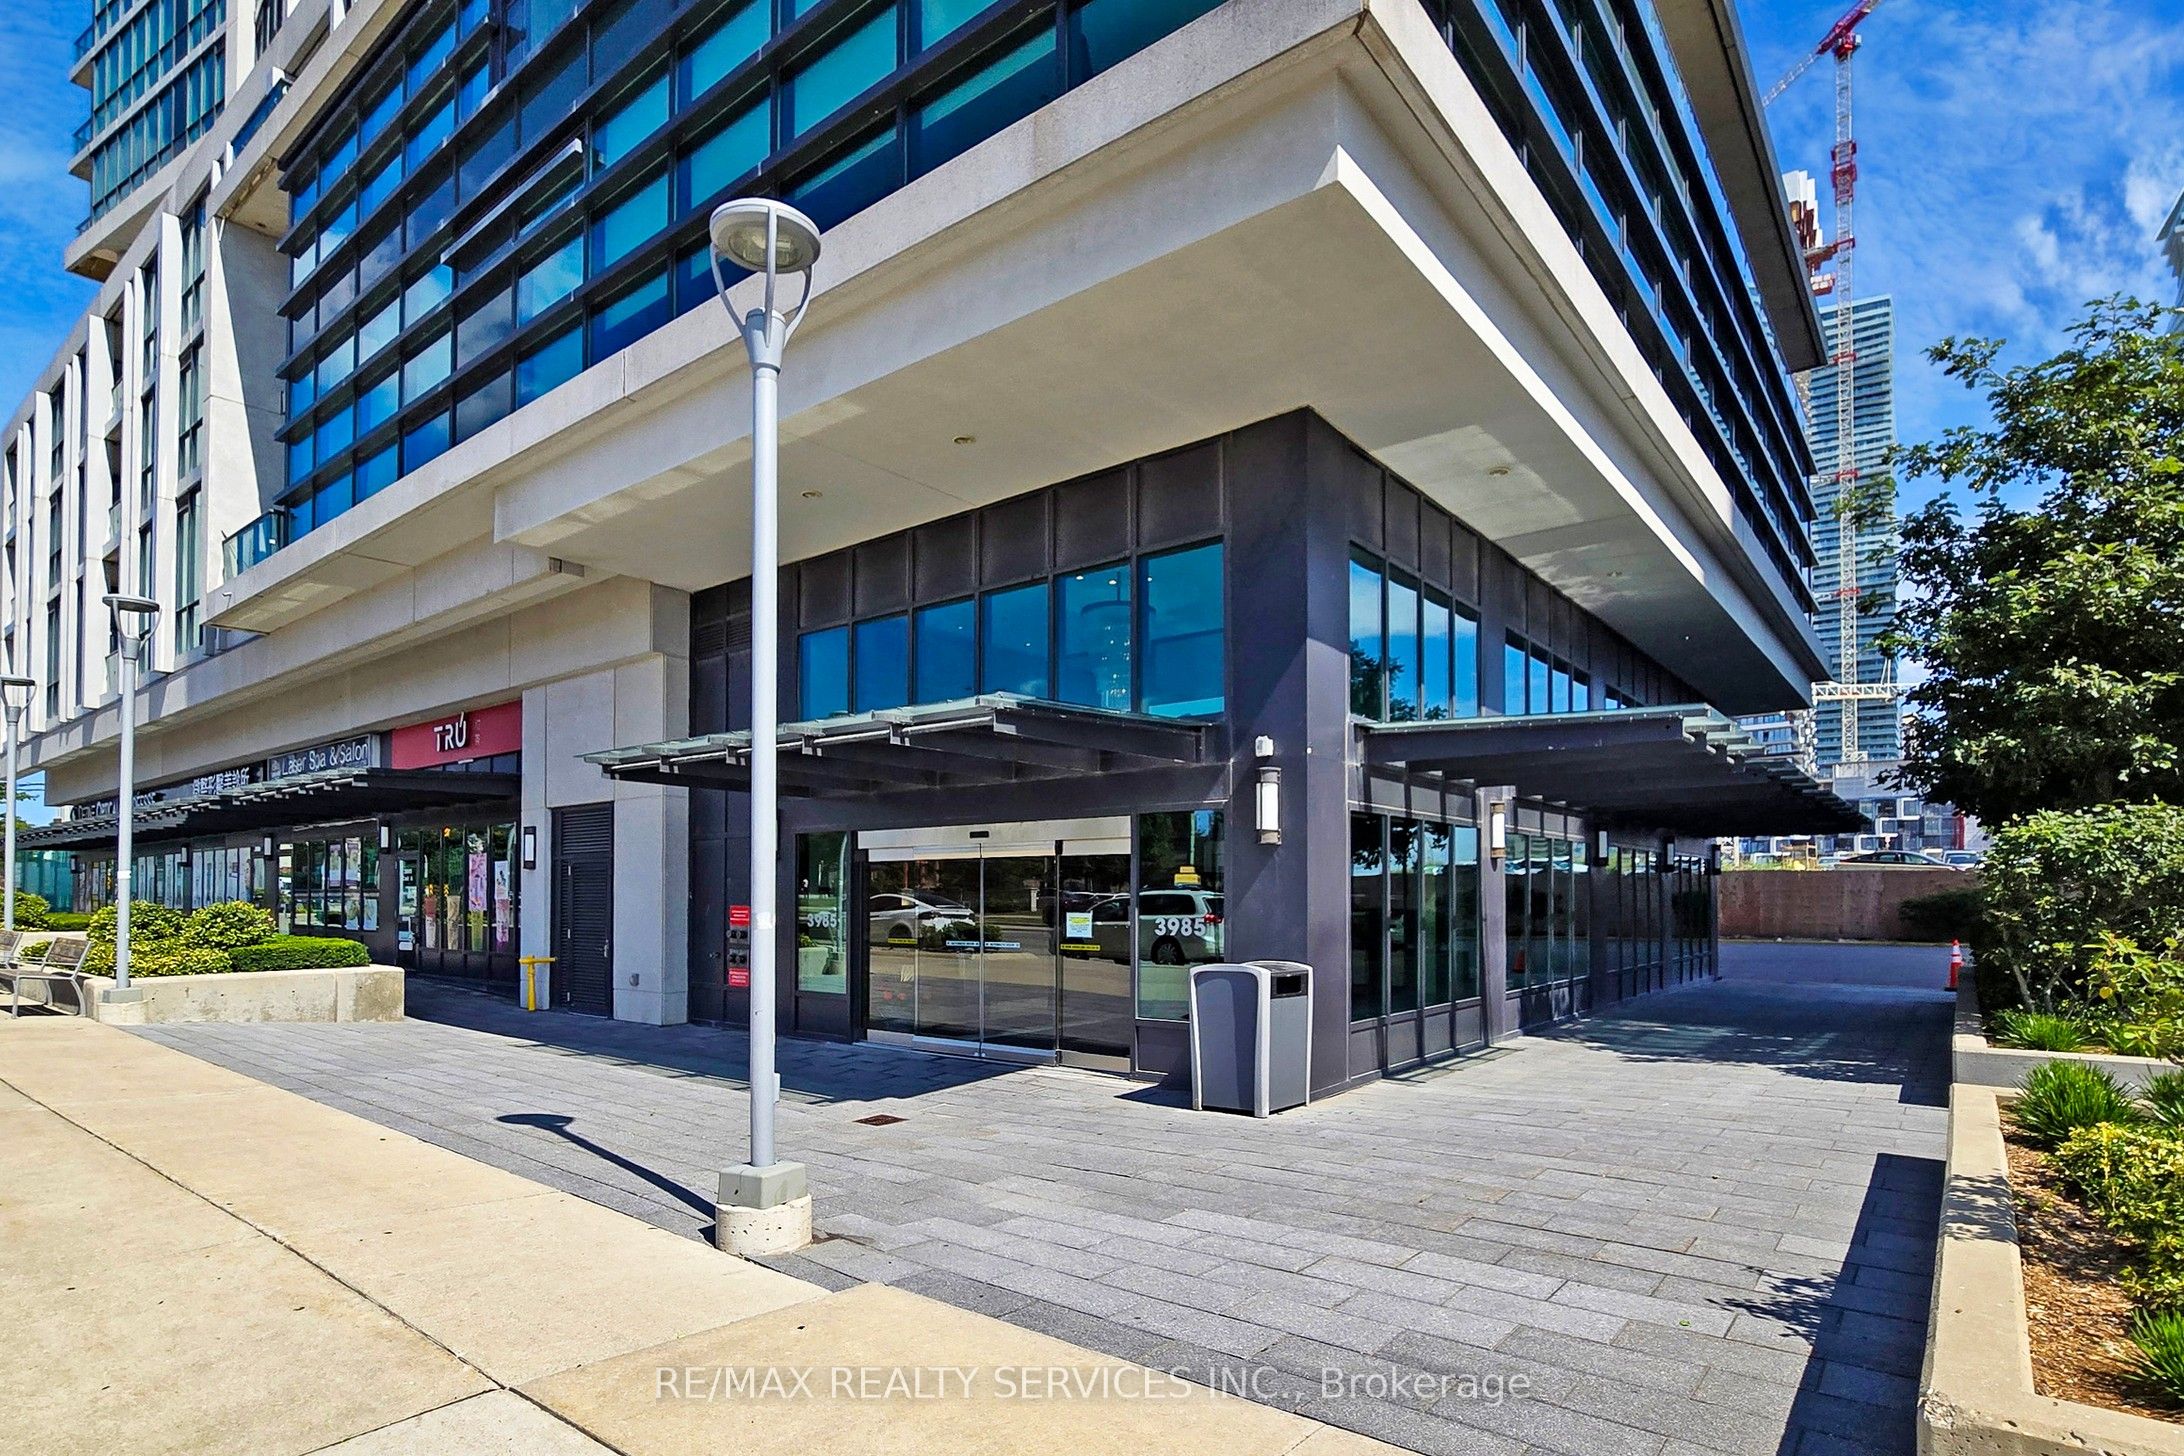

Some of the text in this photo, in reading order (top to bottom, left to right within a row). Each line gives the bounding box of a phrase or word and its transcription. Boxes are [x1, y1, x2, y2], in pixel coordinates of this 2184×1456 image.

[282, 741, 368, 776] Laser Spa & Salon
[807, 913, 838, 928] 3985
[1154, 917, 1206, 937] 3985
